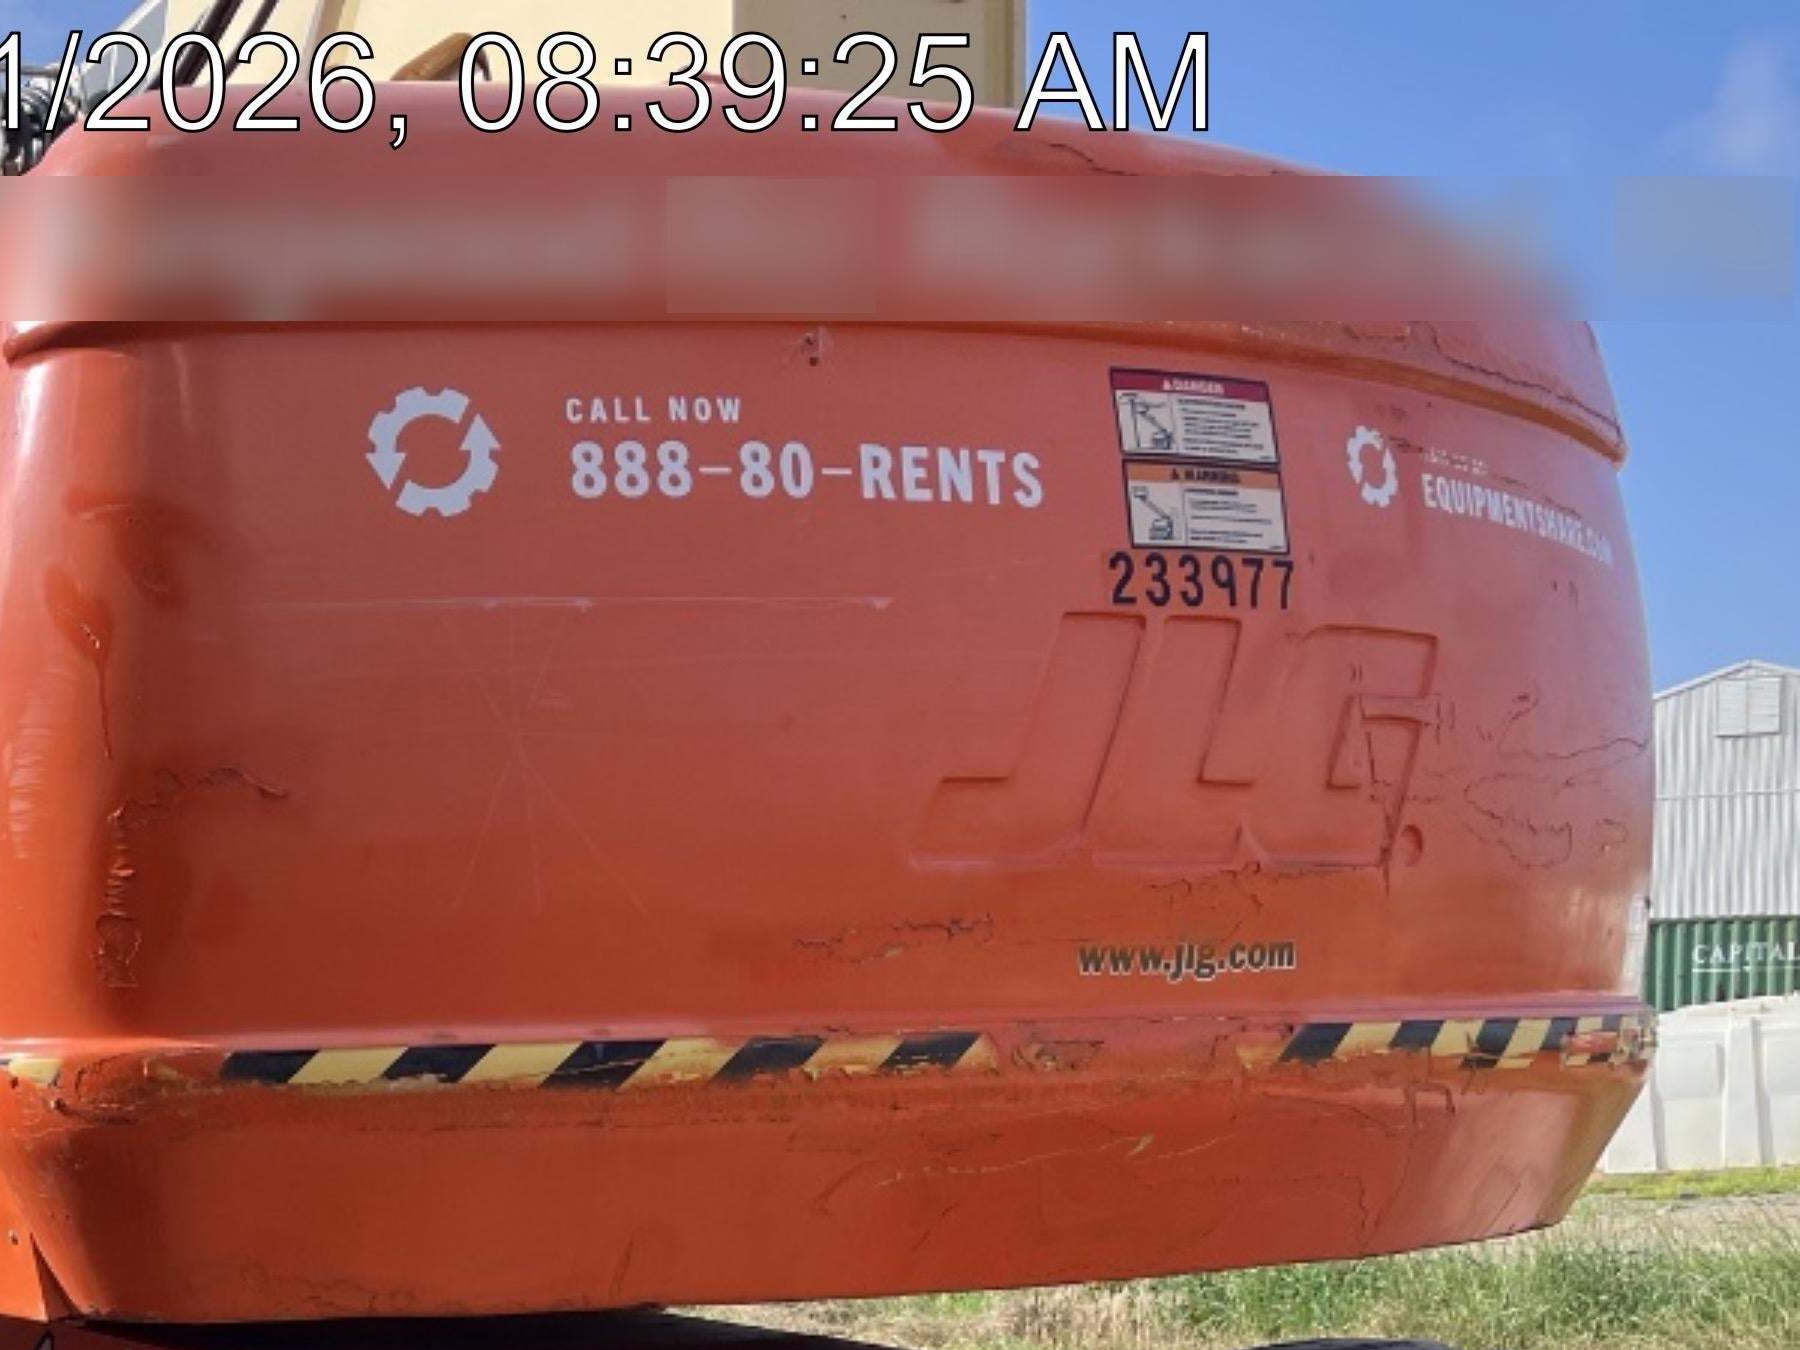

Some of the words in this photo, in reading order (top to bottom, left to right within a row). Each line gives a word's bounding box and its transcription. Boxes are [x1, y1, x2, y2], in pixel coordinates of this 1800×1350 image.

[566, 397, 652, 423] CALL
[668, 397, 742, 424] NOW
[569, 439, 1044, 508] 888-80-RENTS
[1108, 551, 1295, 610] 233977
[1078, 941, 1297, 984] www.jlg.com
